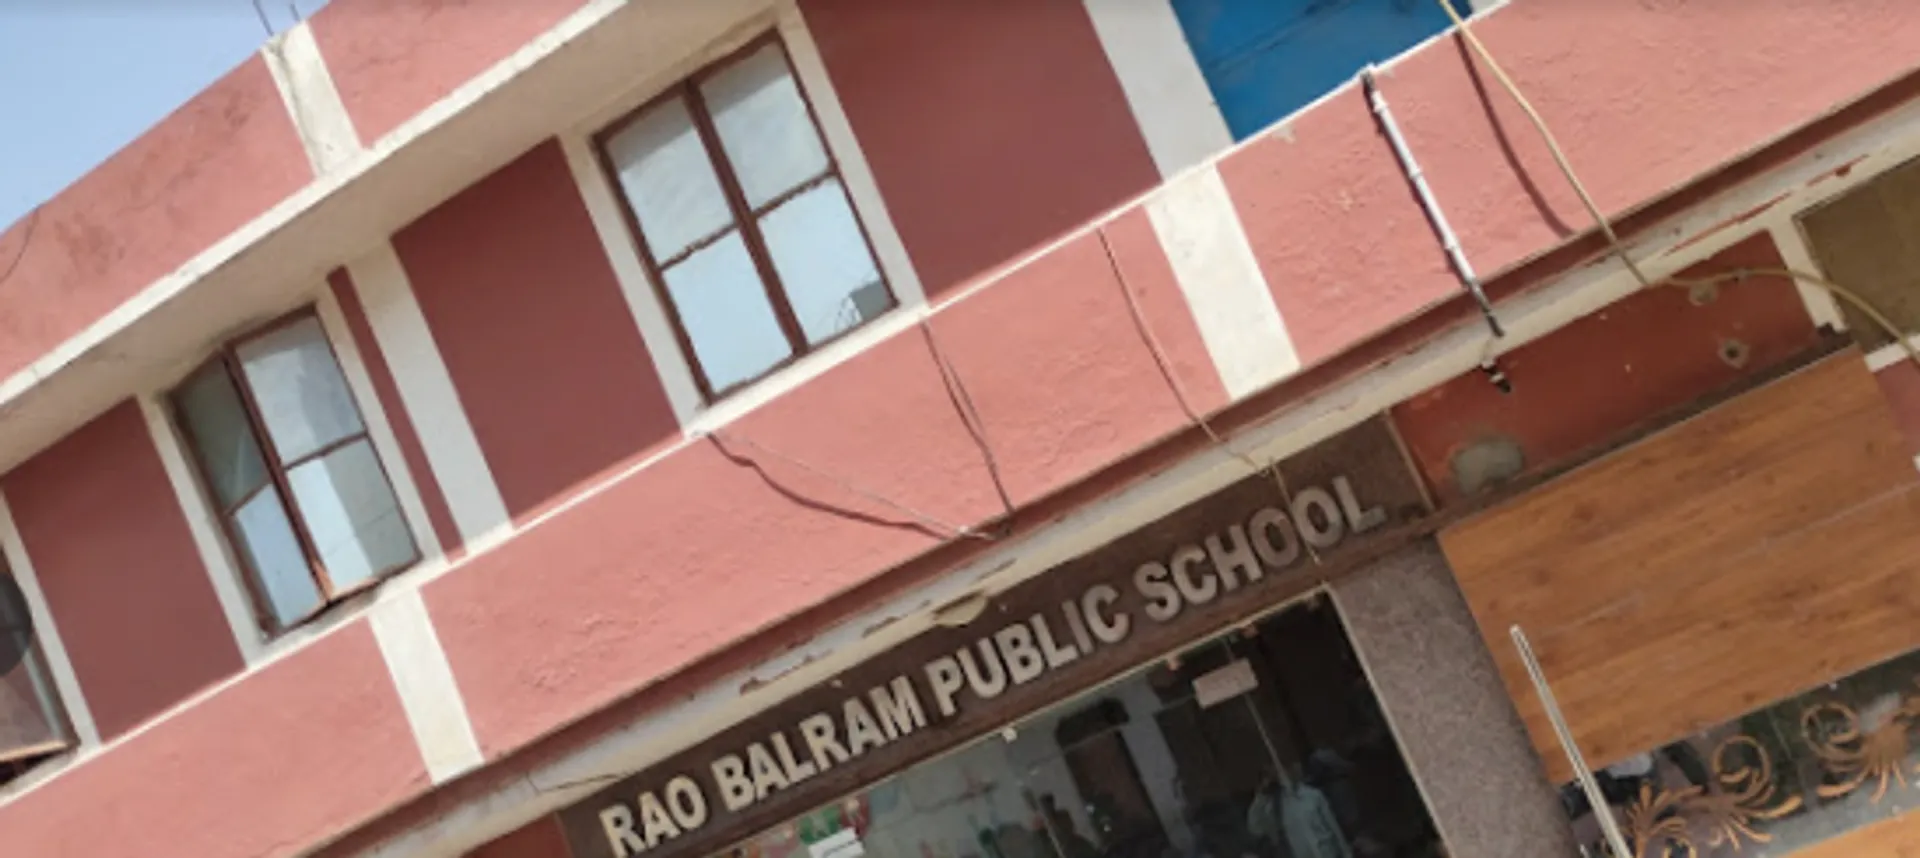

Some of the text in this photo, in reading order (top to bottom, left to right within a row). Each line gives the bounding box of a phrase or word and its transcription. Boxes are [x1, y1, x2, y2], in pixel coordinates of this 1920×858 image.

[600, 477, 1386, 858] RAO BALRAM PUBLIC SCHOOL
